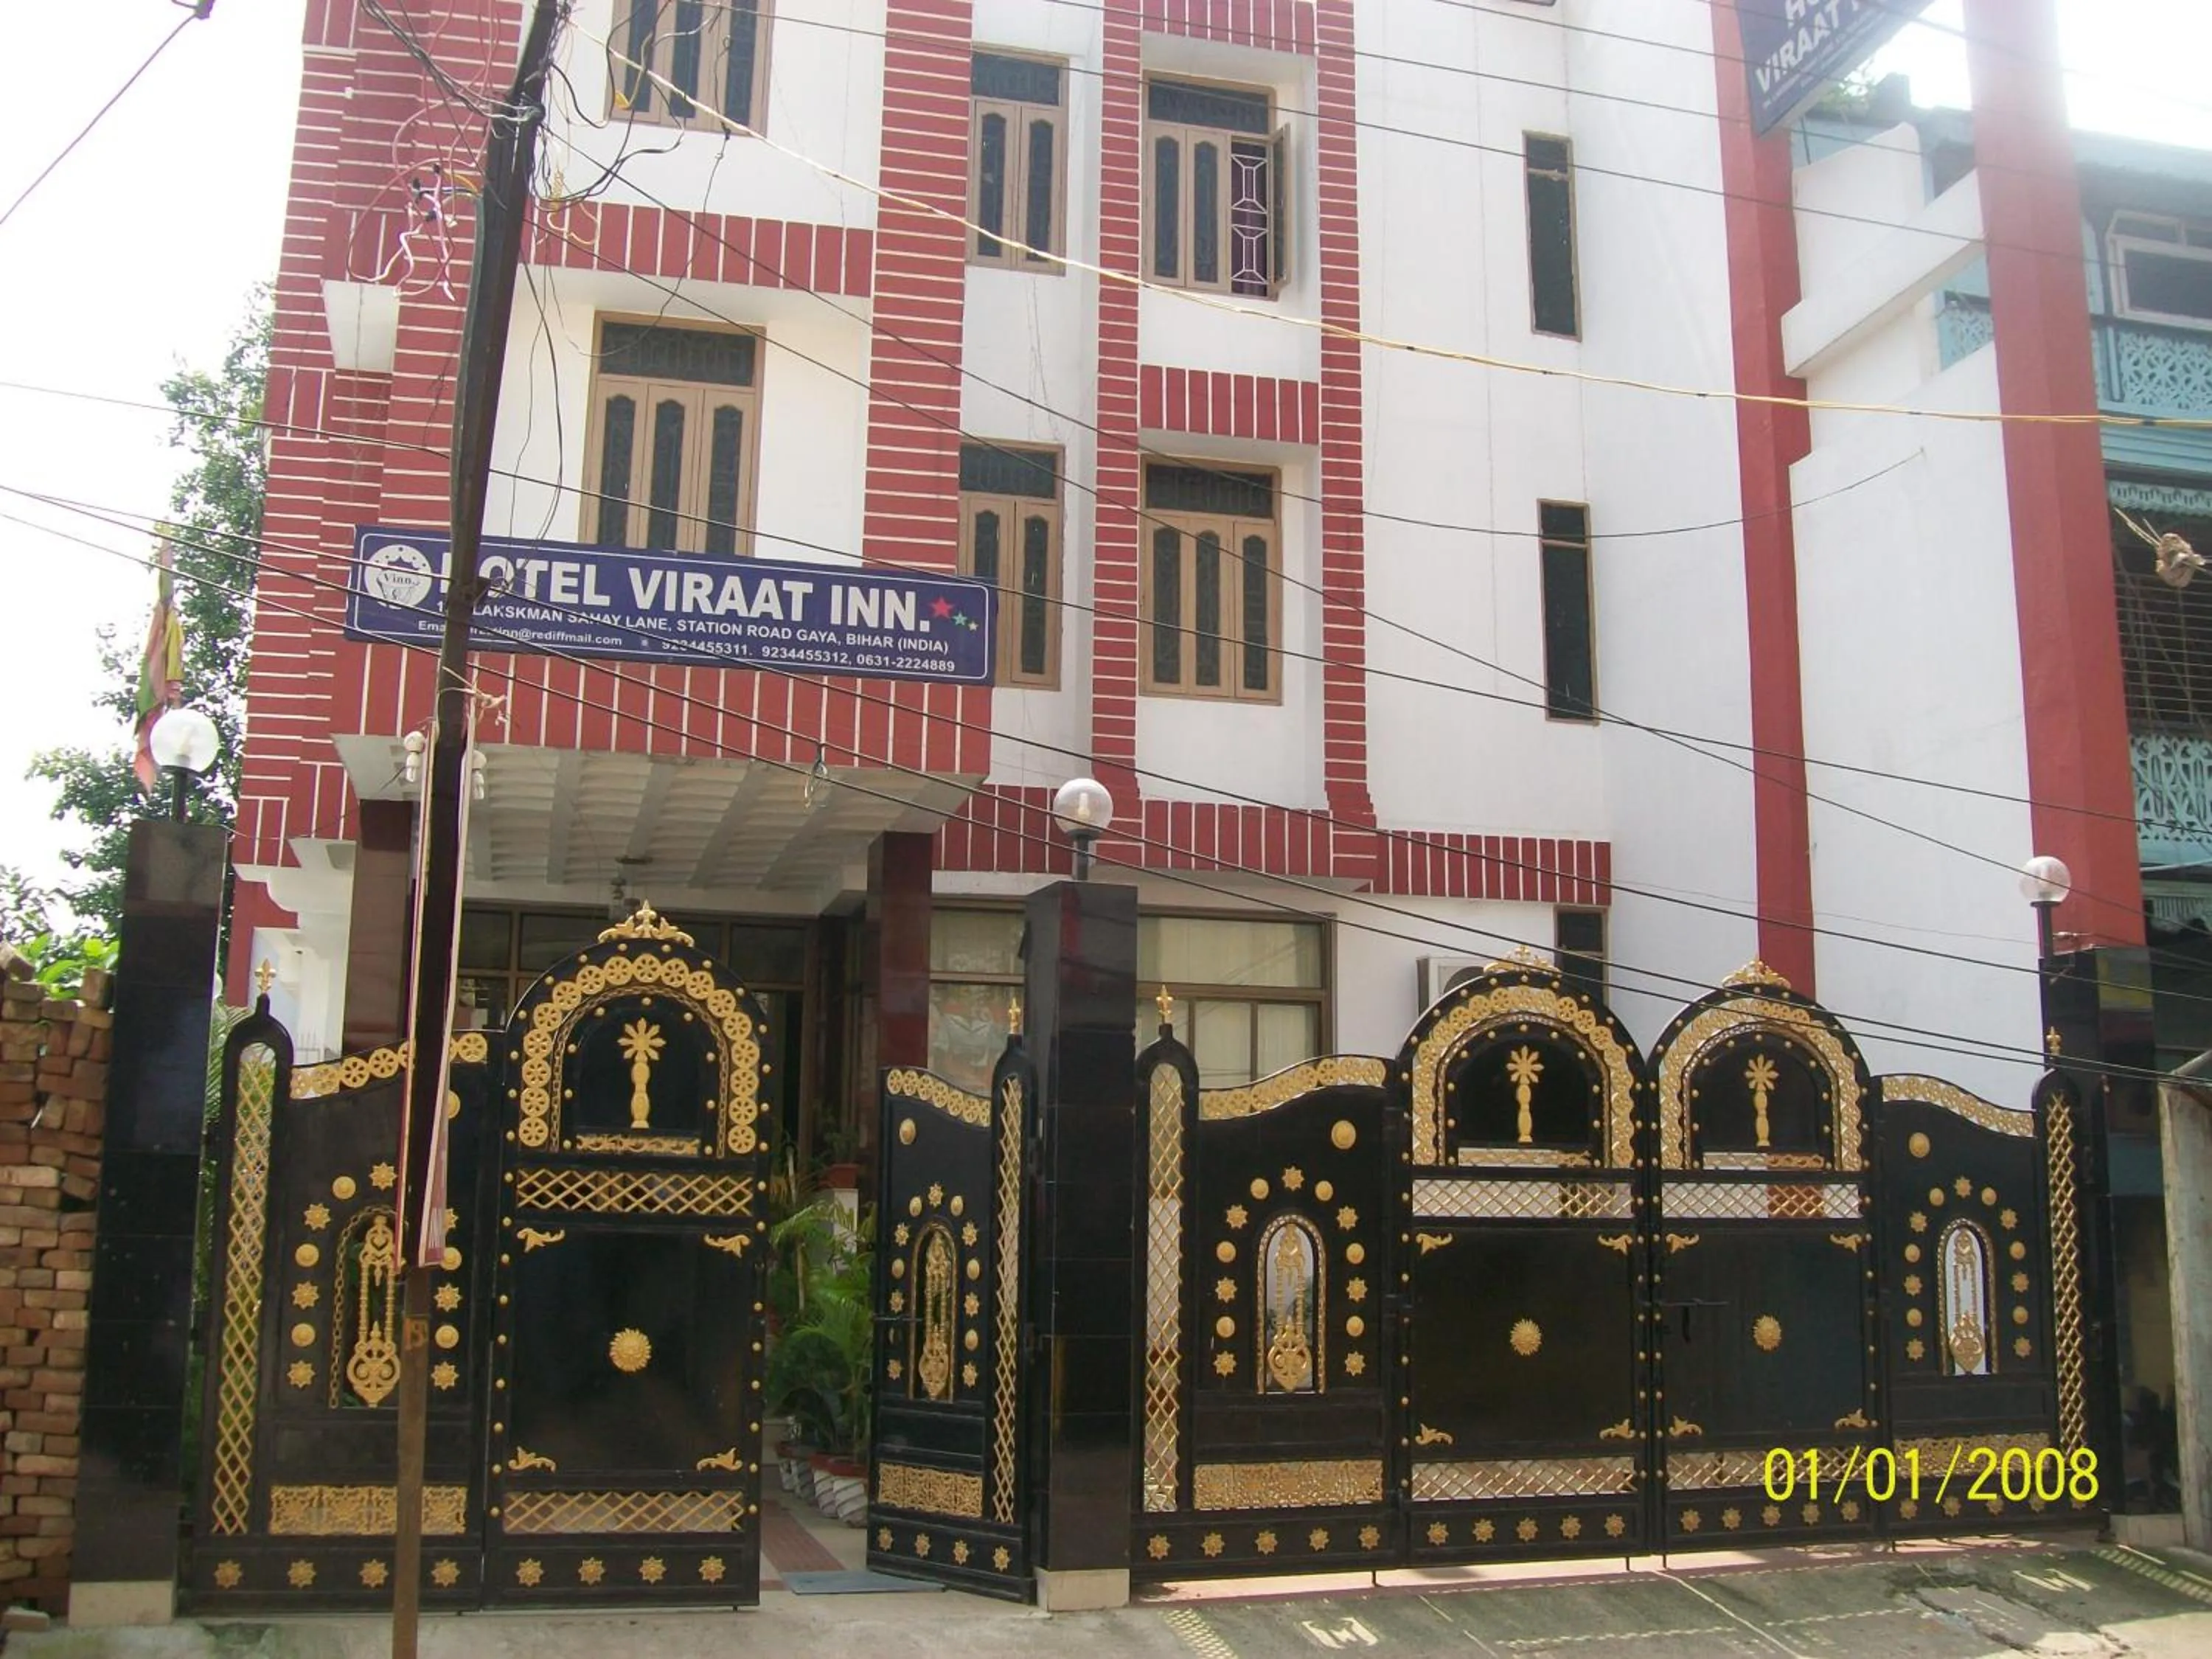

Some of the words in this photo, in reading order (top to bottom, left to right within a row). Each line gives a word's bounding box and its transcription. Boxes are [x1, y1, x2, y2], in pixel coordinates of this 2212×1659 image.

[1756, 0, 1840, 94] VIRAAT
[628, 566, 813, 622] VIRAAT
[830, 584, 931, 633] INN.
[625, 615, 672, 633] LANE,
[677, 619, 742, 636] STATION
[747, 625, 793, 641] ROAD
[796, 630, 841, 647] GAYA,
[846, 633, 893, 649] BIHAR
[897, 639, 950, 655] (INDIA)
[762, 645, 852, 665] 9234455312,
[856, 653, 956, 672] 0631-2224889
